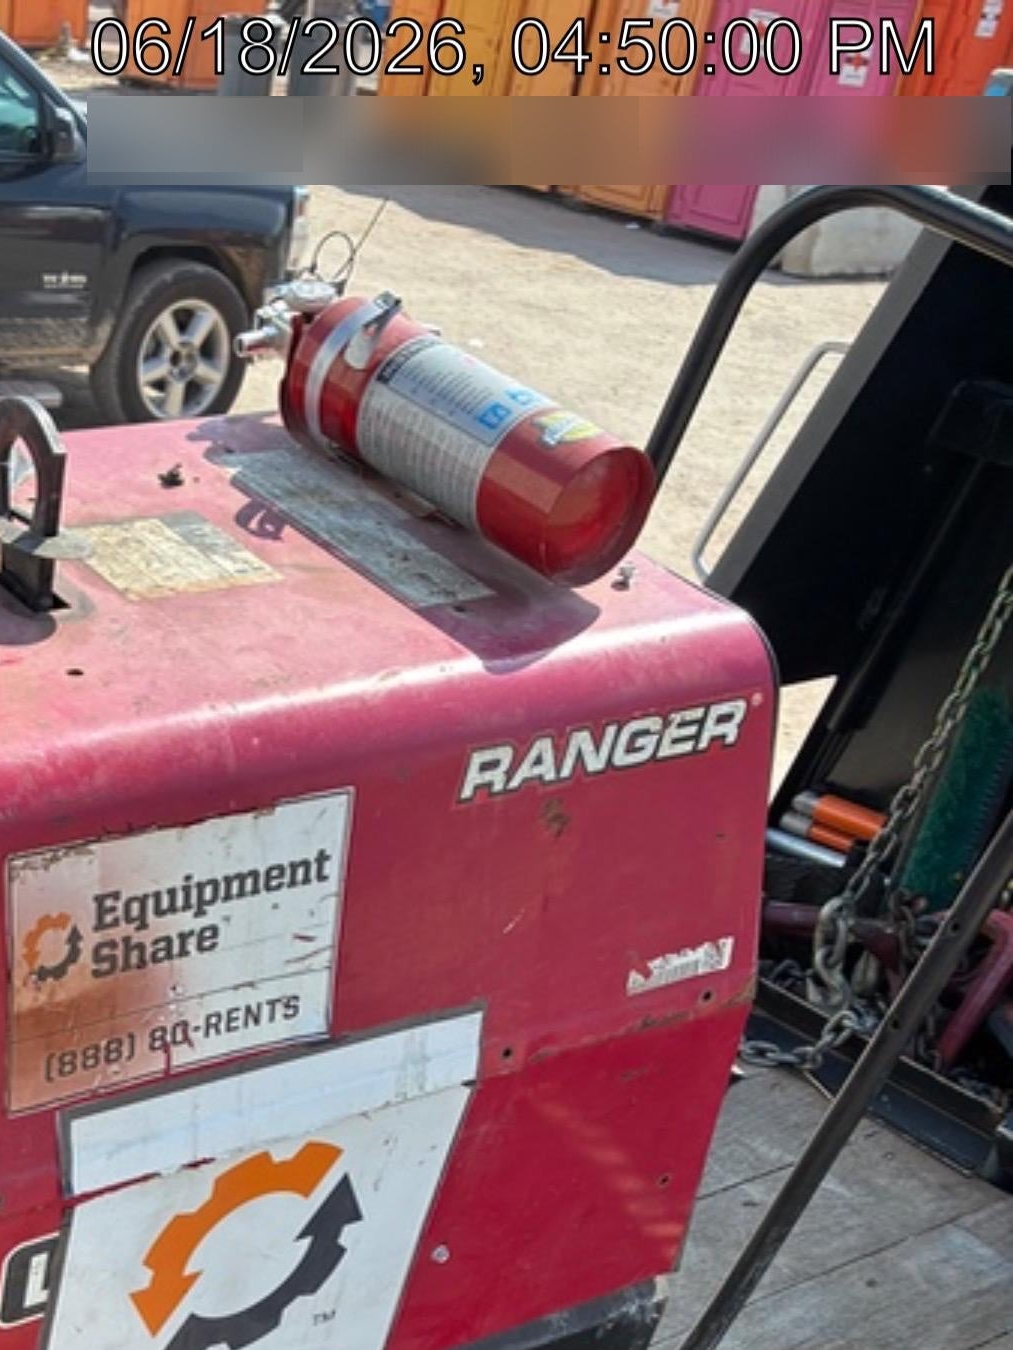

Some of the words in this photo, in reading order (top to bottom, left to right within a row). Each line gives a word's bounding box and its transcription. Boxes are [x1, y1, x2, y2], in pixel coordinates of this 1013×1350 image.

[459, 699, 748, 801] RANGER
[92, 848, 332, 932] Equipment
[91, 922, 220, 979] Share
[44, 1032, 136, 1083] (888)
[148, 995, 301, 1050] 80-RENTS
